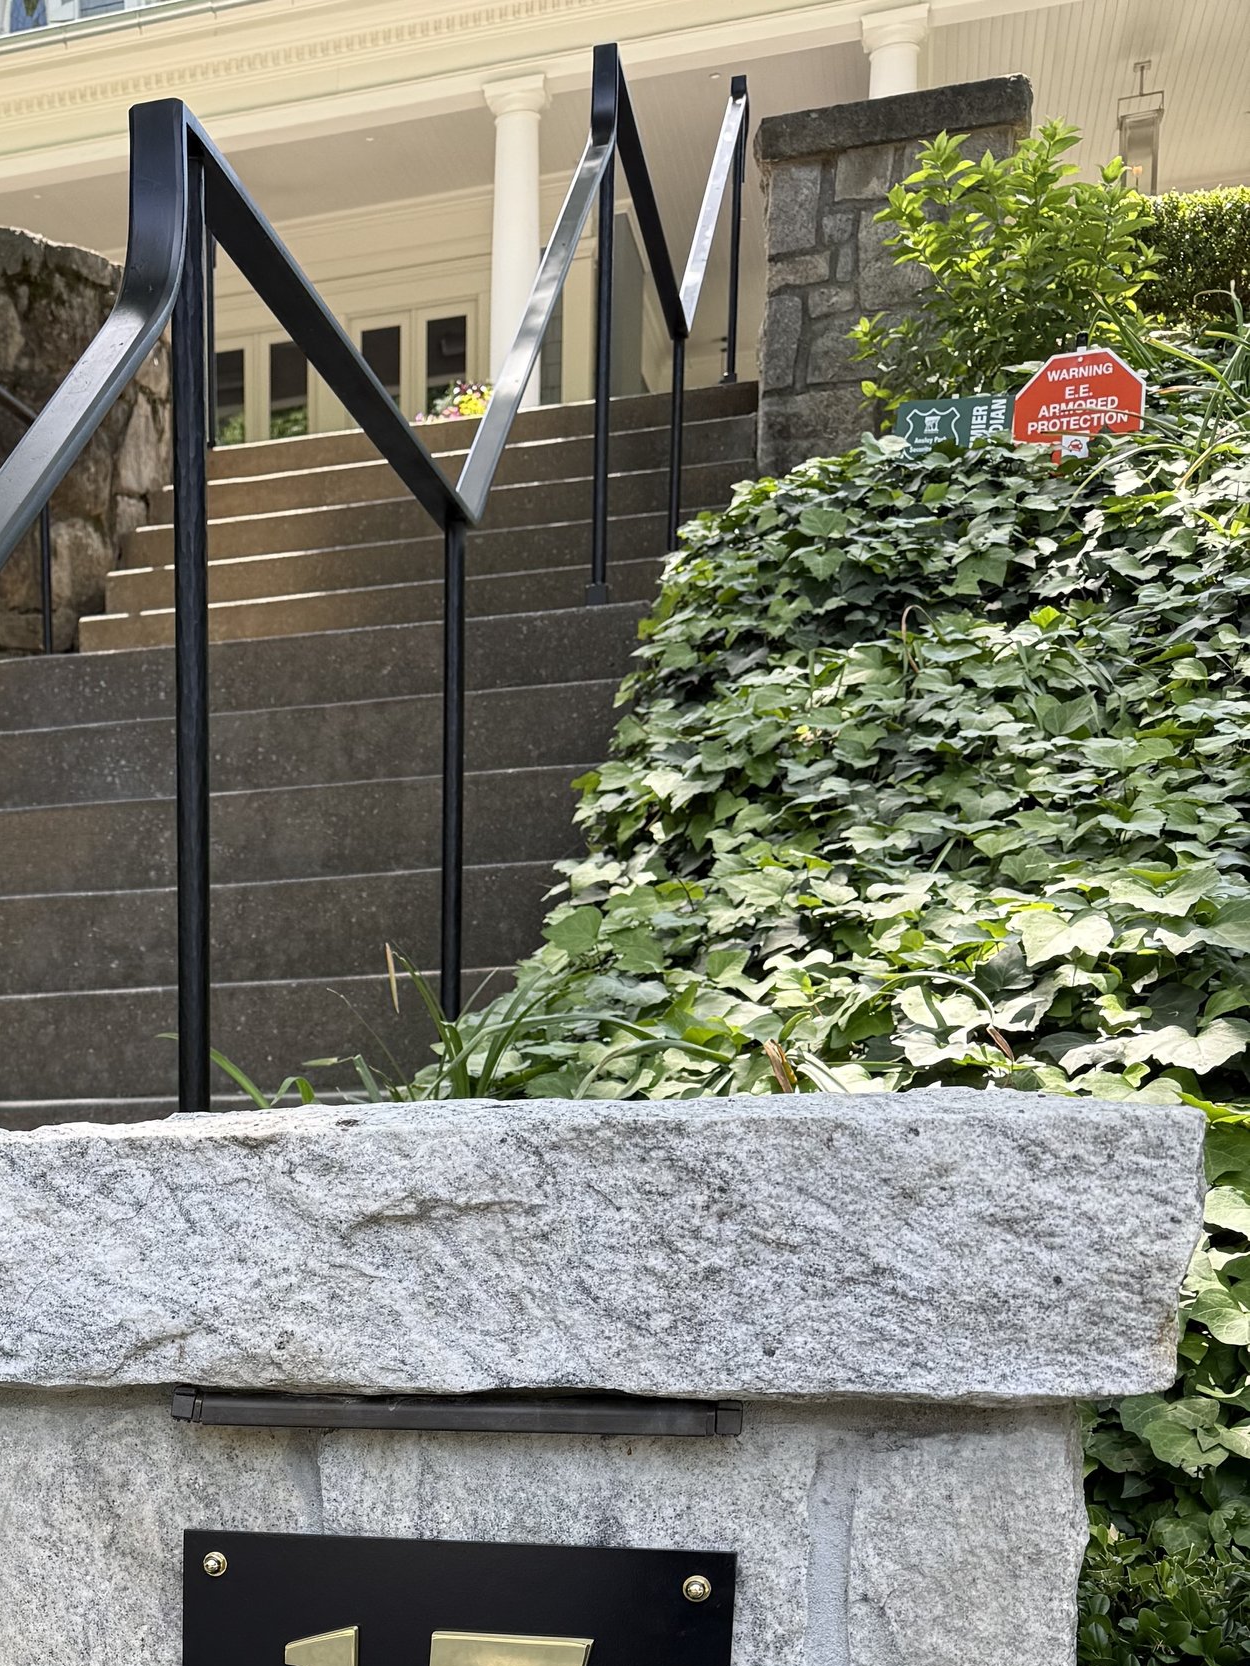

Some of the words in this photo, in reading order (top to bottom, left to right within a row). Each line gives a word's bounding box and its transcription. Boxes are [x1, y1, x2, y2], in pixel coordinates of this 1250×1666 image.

[1047, 362, 1113, 382] WARNING
[1065, 383, 1093, 399] E.E.
[988, 398, 1007, 434] DIAN
[1038, 396, 1119, 418] ARMORED
[968, 405, 988, 449] MIER
[1027, 409, 1129, 435] PROTECTION
